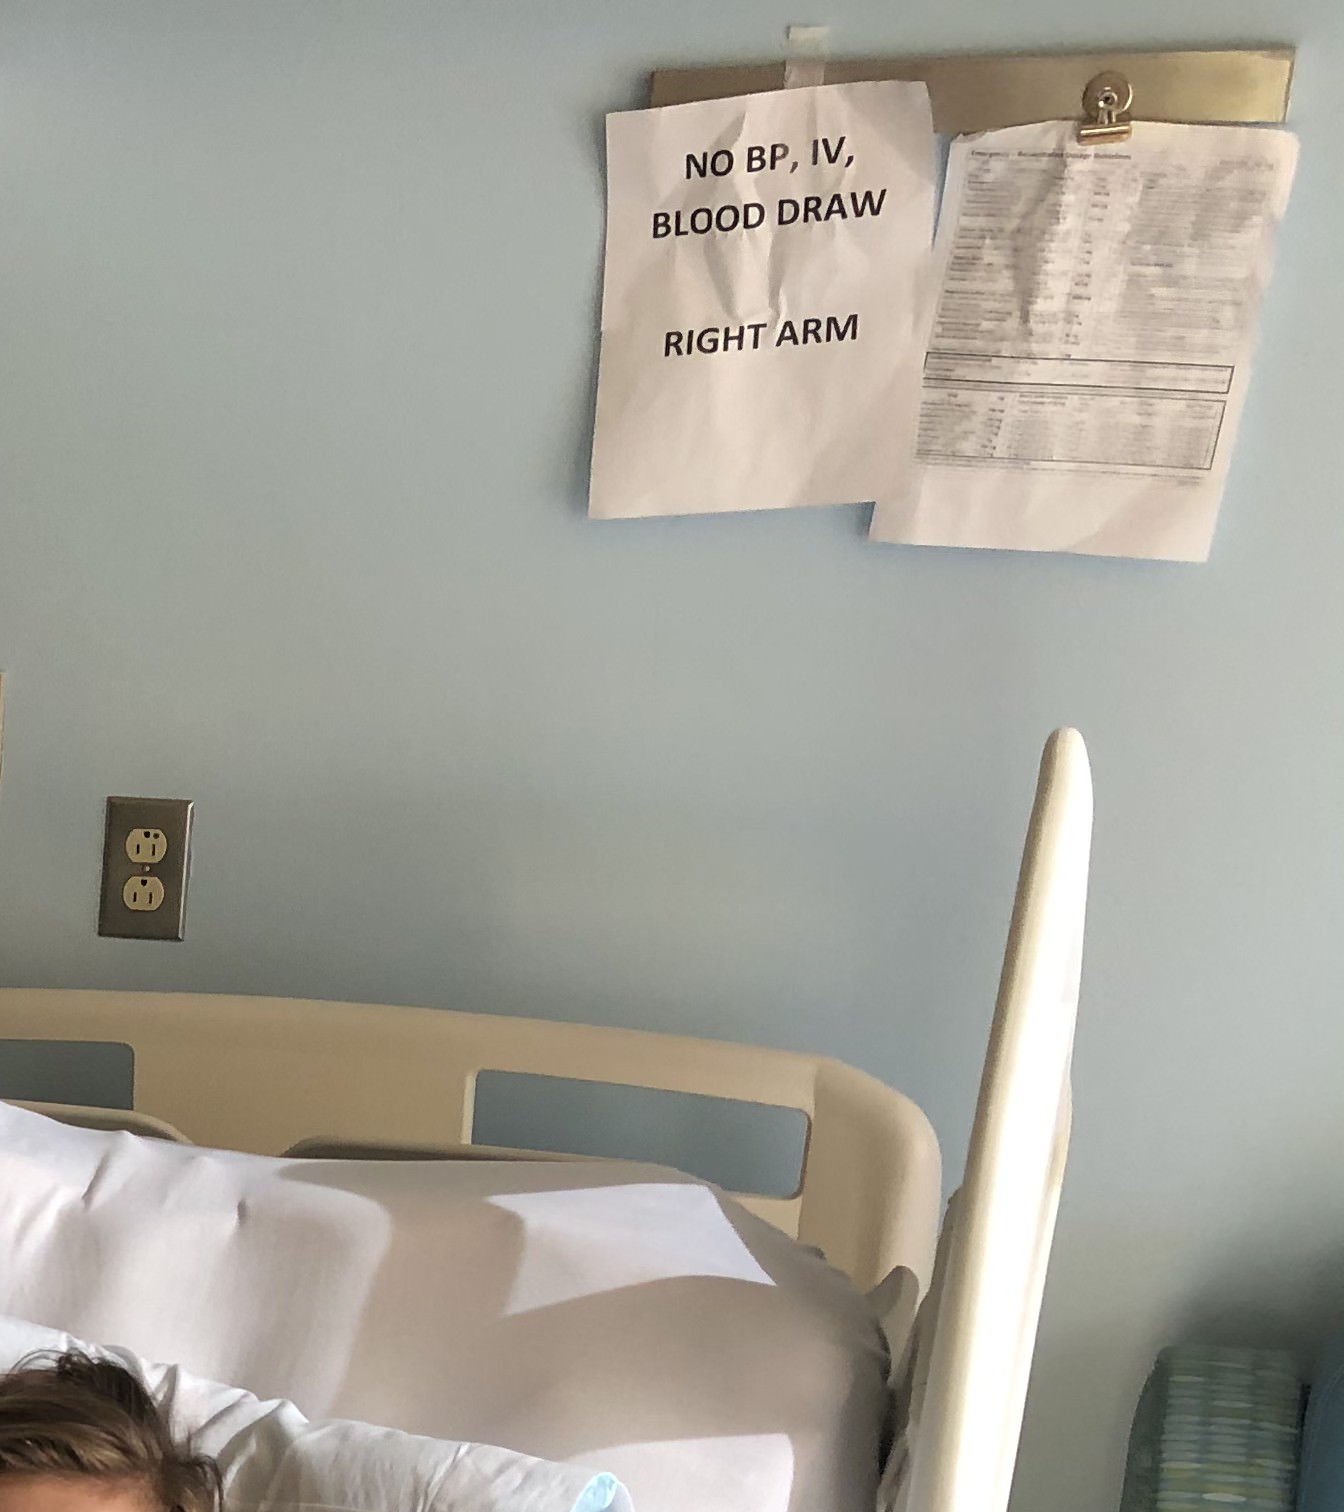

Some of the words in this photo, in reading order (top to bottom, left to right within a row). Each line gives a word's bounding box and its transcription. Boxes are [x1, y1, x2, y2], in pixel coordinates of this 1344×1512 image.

[685, 149, 733, 179] NO
[746, 143, 799, 174] BP,
[811, 136, 854, 168] IV,
[652, 202, 766, 239] BLOOD
[777, 189, 887, 226] DRAW
[664, 323, 767, 357] RIGHT
[775, 314, 859, 347] ARM
